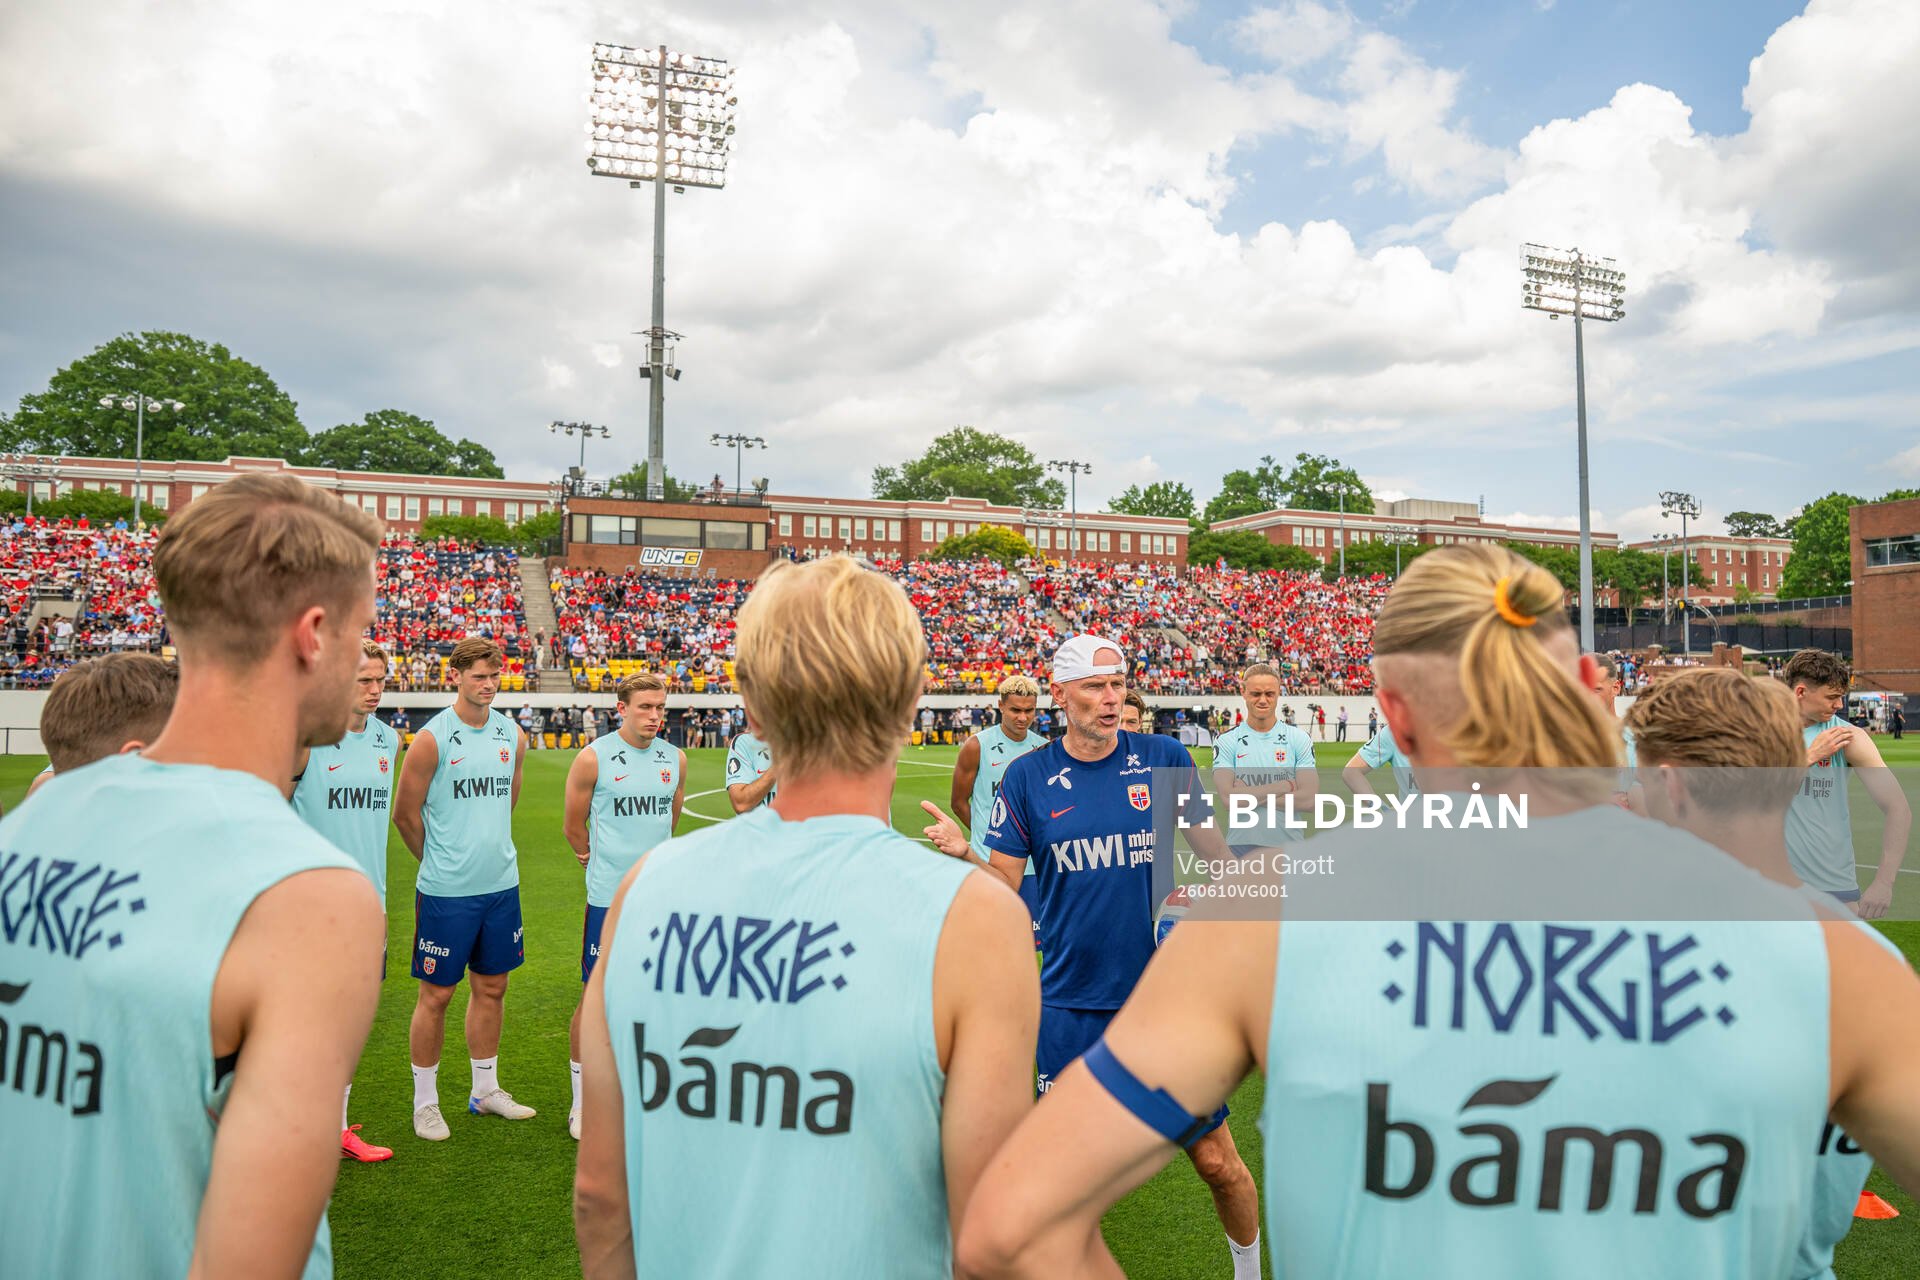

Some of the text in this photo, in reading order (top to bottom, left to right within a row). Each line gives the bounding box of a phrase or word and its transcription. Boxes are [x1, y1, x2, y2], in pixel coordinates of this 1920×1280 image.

[640, 547, 702, 567] UNCG
[453, 776, 495, 800] KIWI
[496, 775, 511, 786] mini
[1812, 777, 1834, 788] mini
[327, 787, 372, 810] KIWI
[373, 786, 389, 798] mini
[496, 786, 509, 798] pris
[1812, 788, 1831, 800] pris
[372, 798, 387, 812] pris
[613, 795, 657, 817] KIWI
[1127, 828, 1157, 848] mini
[1050, 833, 1126, 873] KIWI
[1129, 846, 1155, 869] pris
